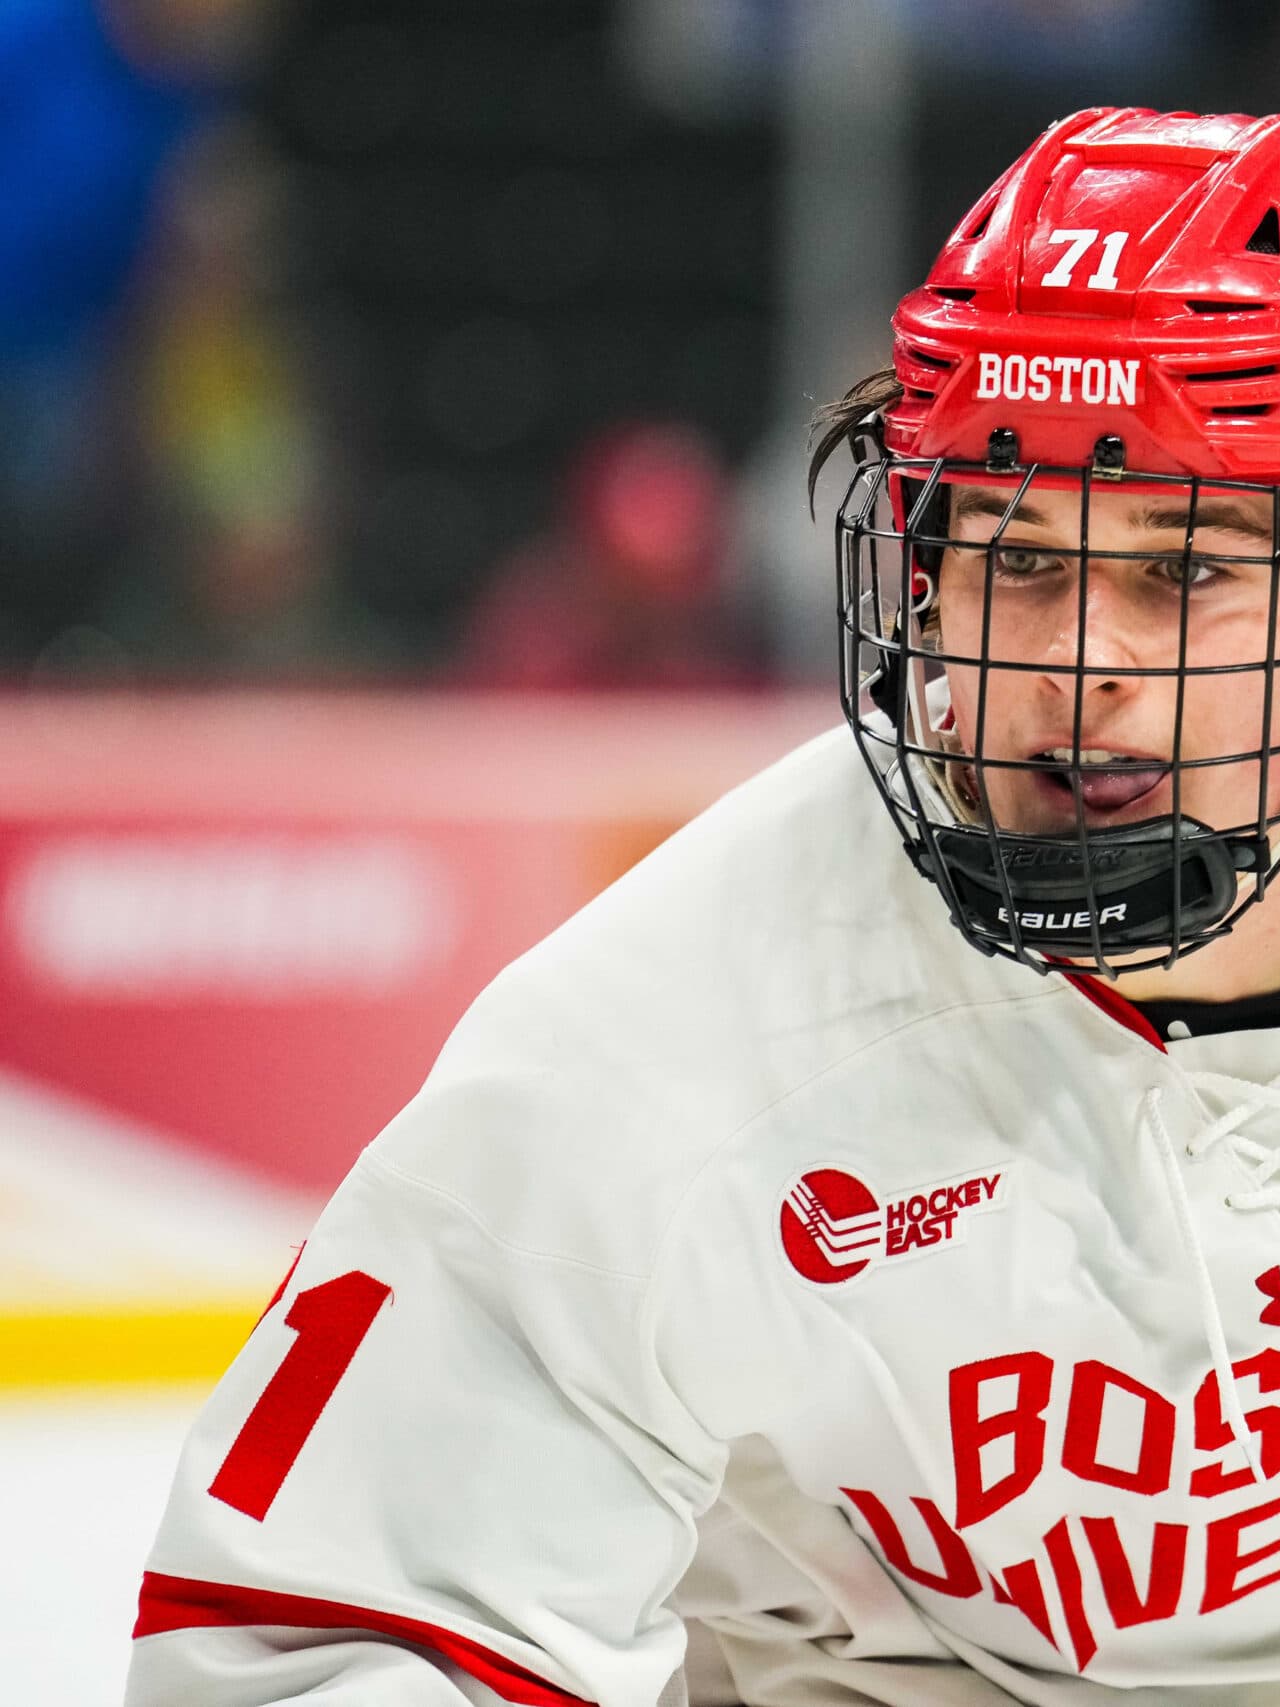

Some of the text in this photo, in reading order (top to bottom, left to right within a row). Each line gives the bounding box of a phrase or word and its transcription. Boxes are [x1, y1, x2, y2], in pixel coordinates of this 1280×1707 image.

[1041, 229, 1129, 290] 71
[977, 352, 1140, 406] BOSTON
[887, 1174, 1001, 1229] HOCKEY
[886, 1211, 958, 1256] EAST
